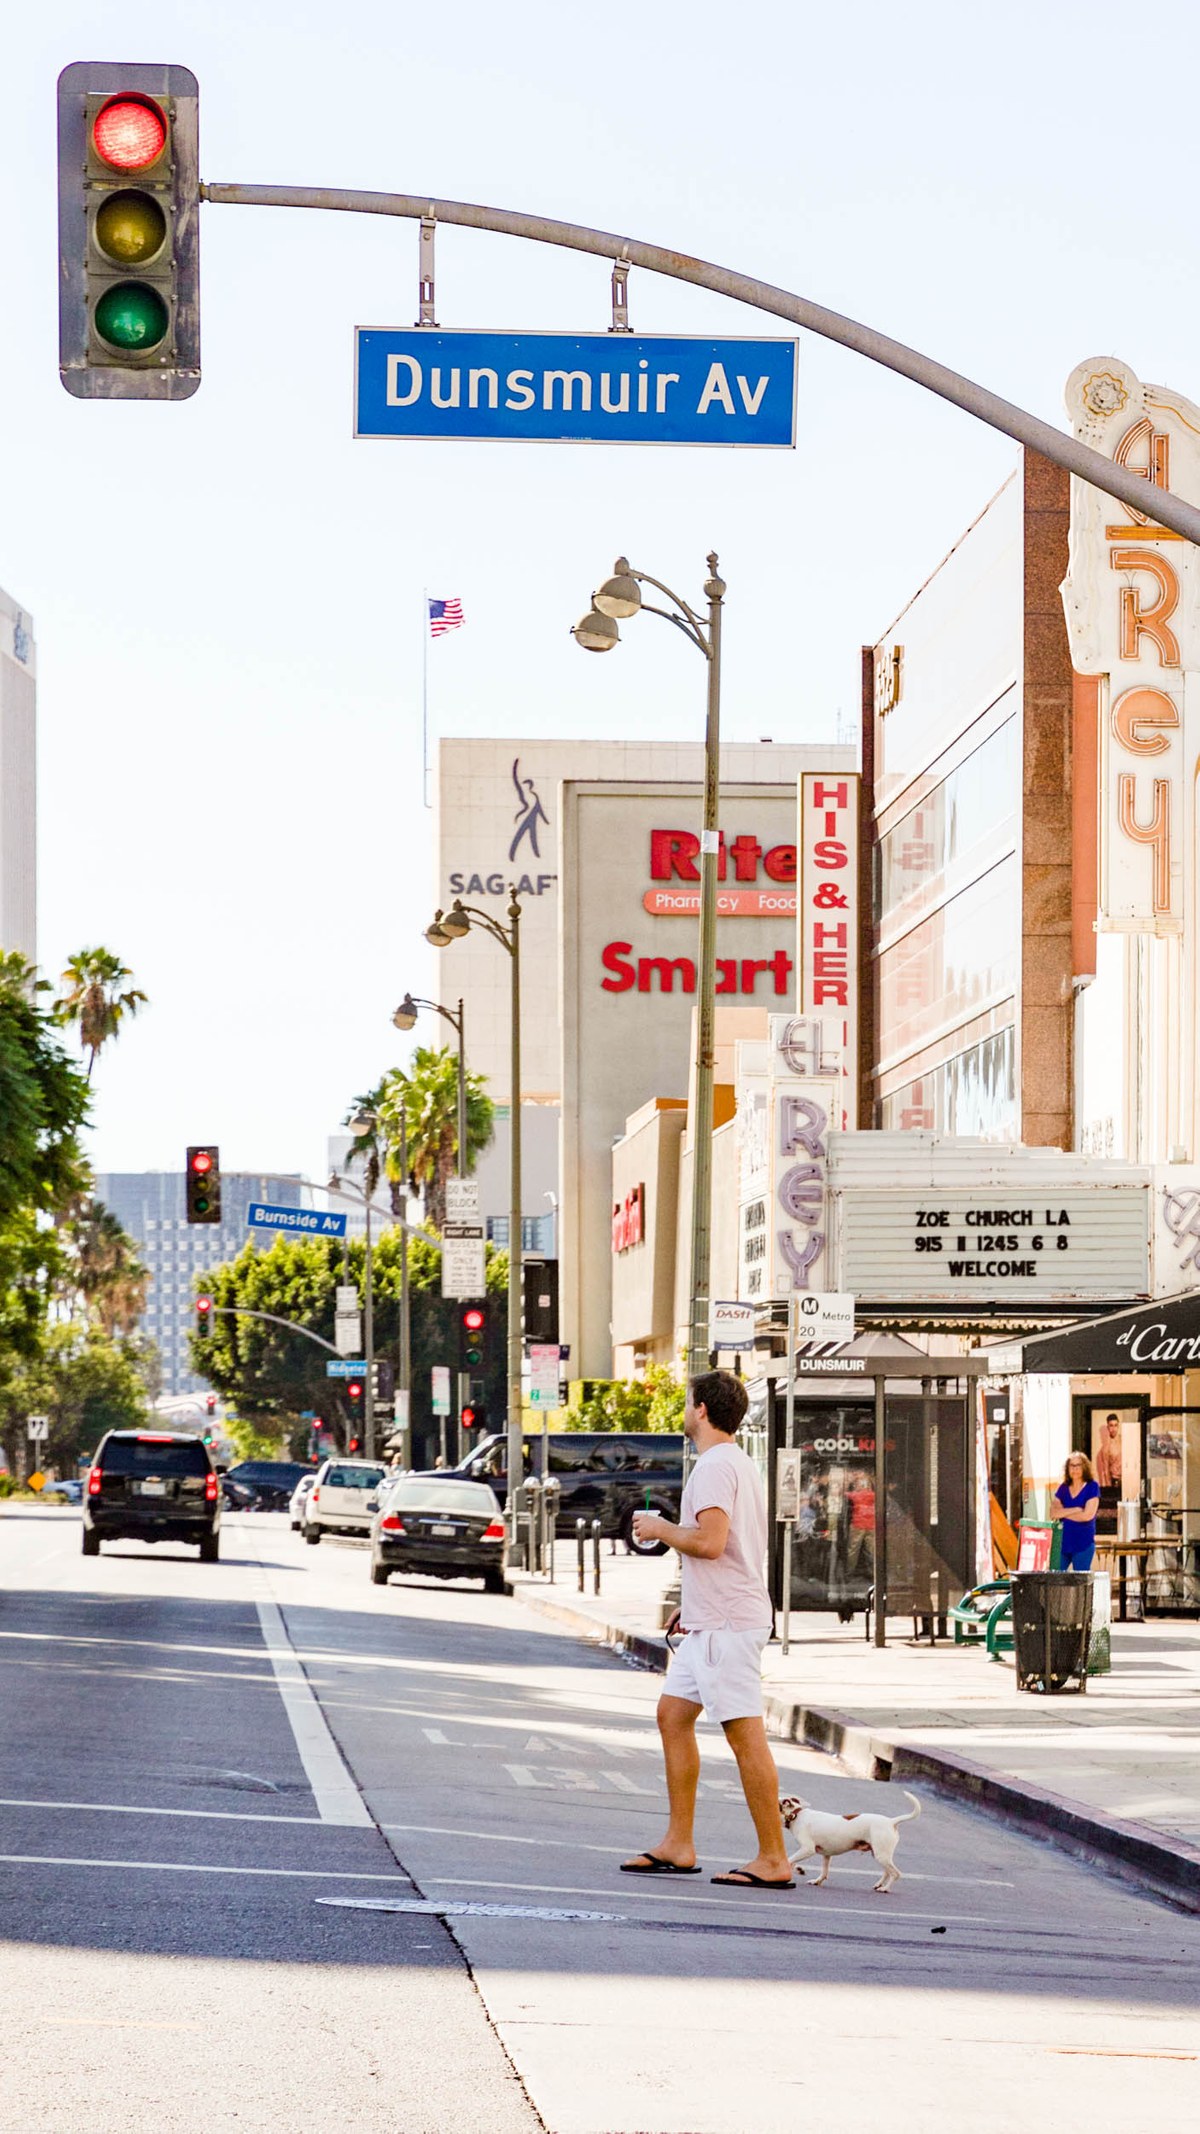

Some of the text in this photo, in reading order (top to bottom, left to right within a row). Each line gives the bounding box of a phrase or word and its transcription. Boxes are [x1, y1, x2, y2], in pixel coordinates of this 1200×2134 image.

[386, 353, 770, 416] Dunsmuir Av
[813, 781, 848, 869] HIS
[655, 893, 739, 911] Pharmcy
[813, 882, 850, 909] &
[254, 1207, 341, 1231] Burnside Av
[915, 1209, 1071, 1228] ZOE CHURCH LA
[914, 1236, 943, 1252] 915
[1031, 1235, 1044, 1251] 6
[1056, 1235, 1069, 1251] 8
[947, 1260, 1037, 1277] WELCOME
[716, 1309, 751, 1320] DASH
[822, 1311, 851, 1322] Metro
[799, 1326, 816, 1337] 20
[800, 1359, 866, 1371] DUNSMUIR
